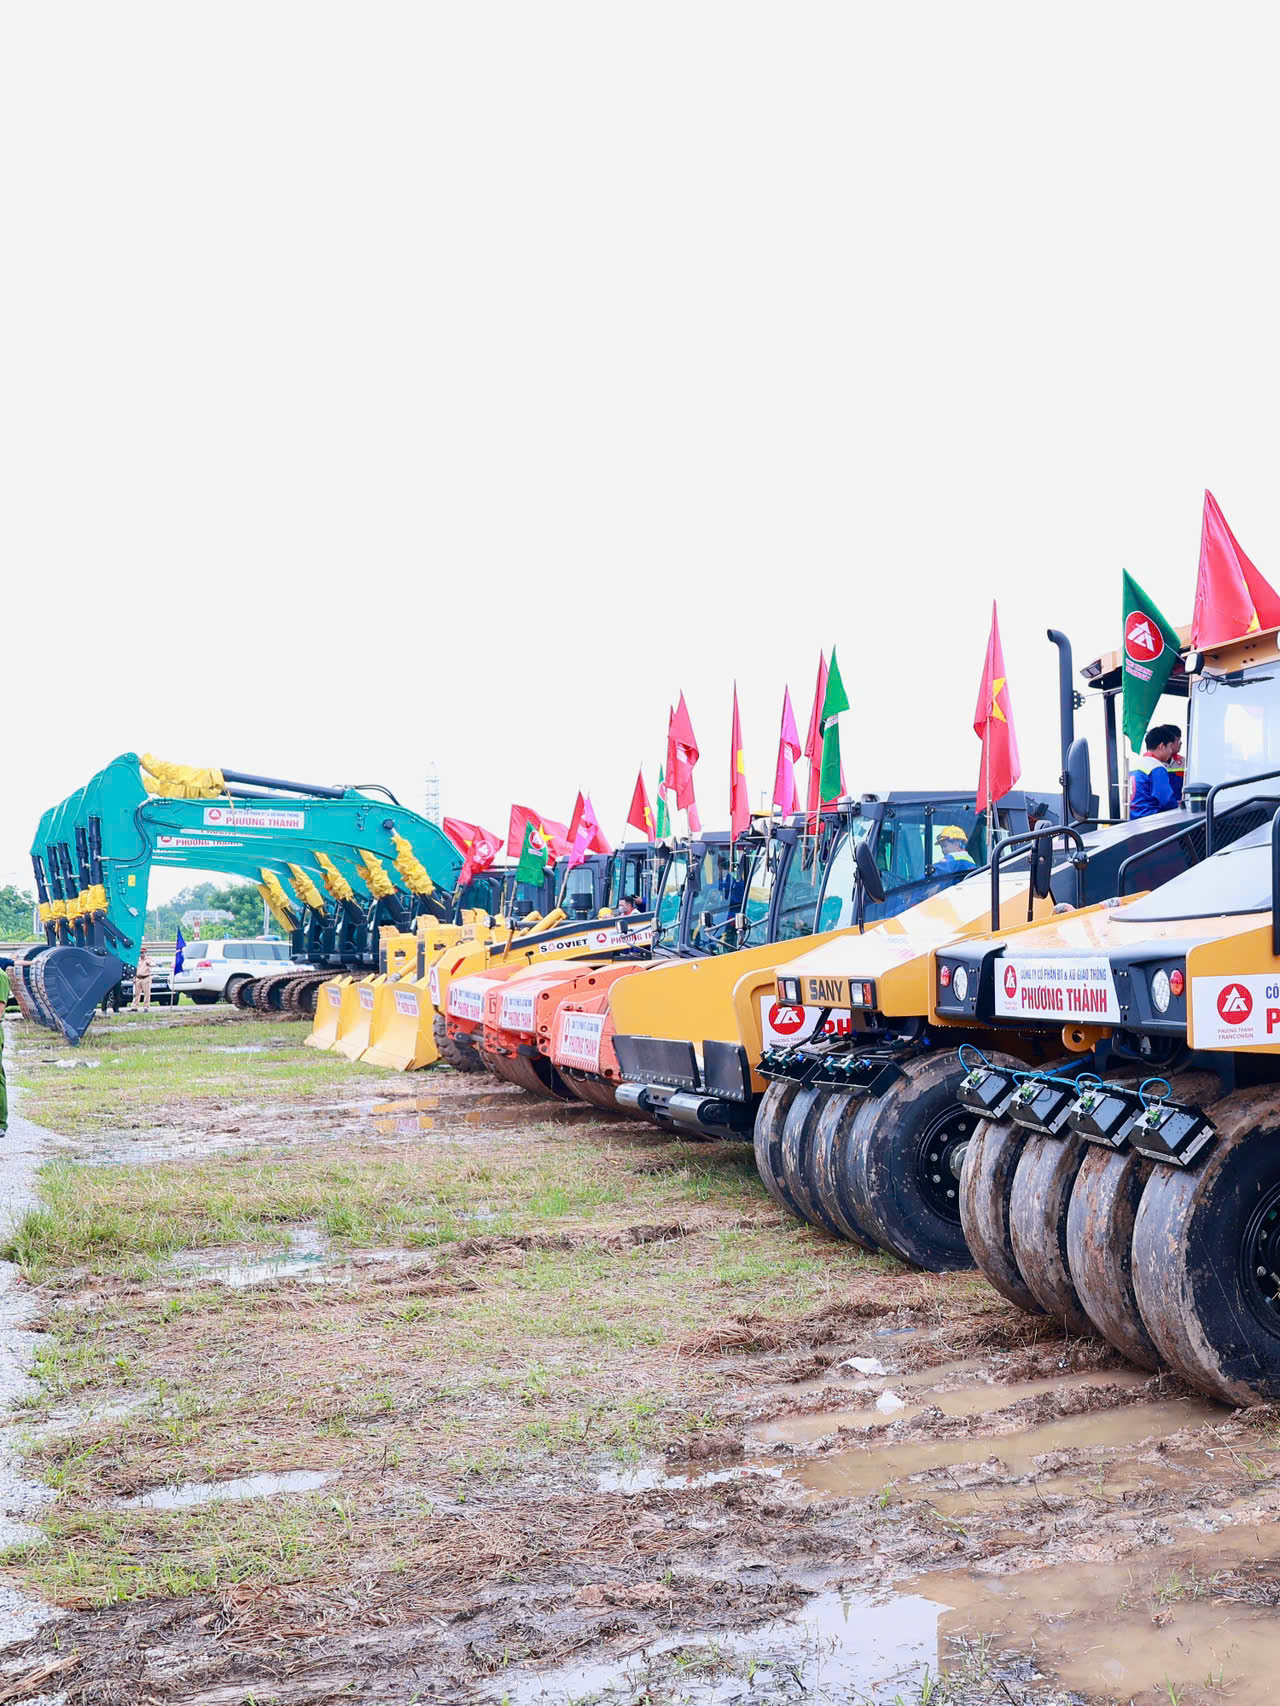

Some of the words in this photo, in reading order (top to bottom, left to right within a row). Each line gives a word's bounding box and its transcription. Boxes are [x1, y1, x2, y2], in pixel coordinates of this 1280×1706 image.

[809, 979, 843, 1001] SANY
[1021, 985, 1063, 1011] PHƯƠNG
[1066, 983, 1107, 1013] THÀNH
